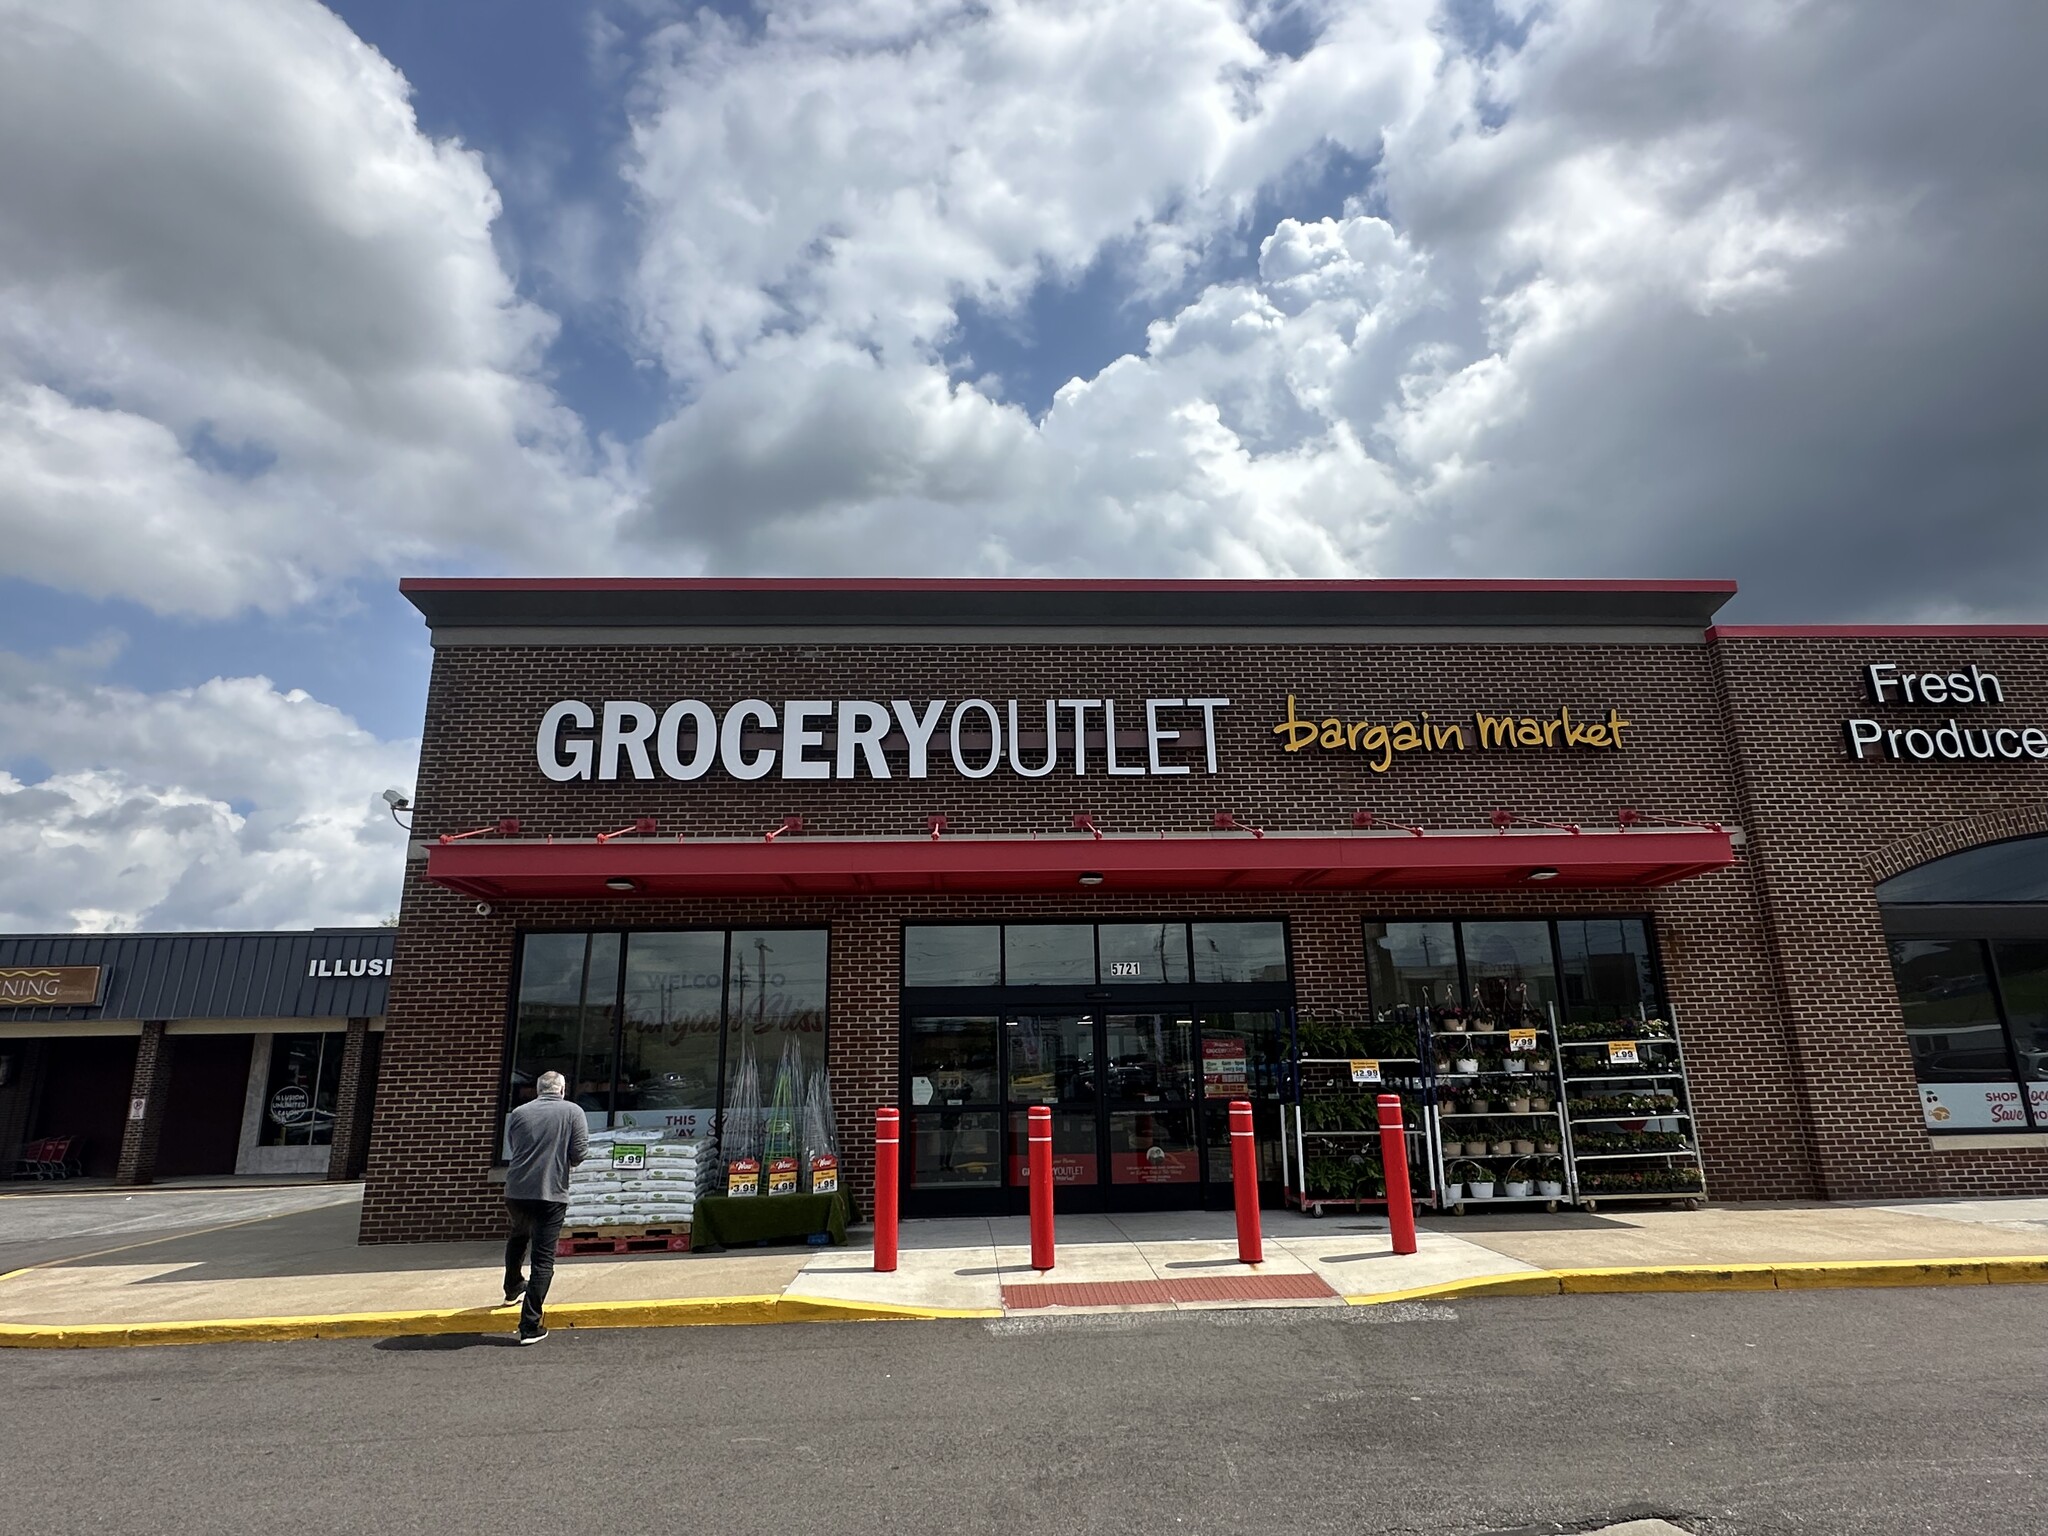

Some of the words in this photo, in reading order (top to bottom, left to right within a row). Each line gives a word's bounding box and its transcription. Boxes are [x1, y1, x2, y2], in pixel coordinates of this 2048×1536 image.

[1869, 663, 2004, 703] Fresh
[536, 698, 1230, 781] GROCERYOUTLET
[1274, 694, 1464, 773] bargain
[1475, 705, 1630, 749] market
[1852, 719, 2048, 760] Produce
[308, 959, 392, 977] ILLUSI
[1112, 963, 1138, 975] 5721
[0, 979, 60, 996] NING
[648, 974, 752, 989] WELCOE
[1985, 1092, 2018, 1102] SHOP
[665, 1115, 696, 1126] THIS
[1991, 1104, 2024, 1123] Save
[675, 1129, 696, 1137] AY
